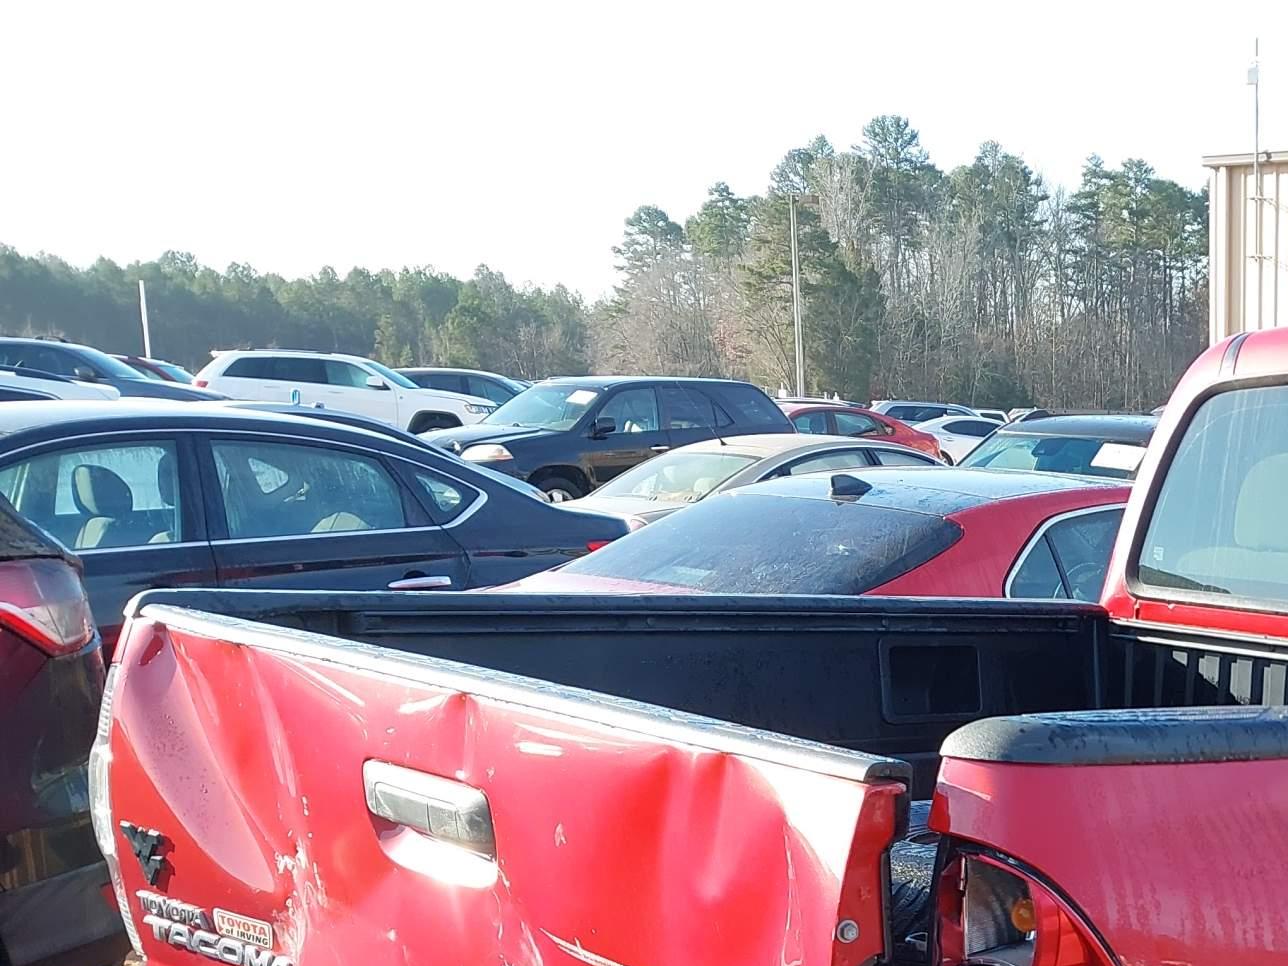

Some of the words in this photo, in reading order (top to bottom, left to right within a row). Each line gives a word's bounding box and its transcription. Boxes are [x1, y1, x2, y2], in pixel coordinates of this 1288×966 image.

[136, 890, 207, 928] TOYOTA
[219, 914, 268, 938] TOYOTA
[225, 927, 235, 936] of
[236, 930, 269, 947] IRVING
